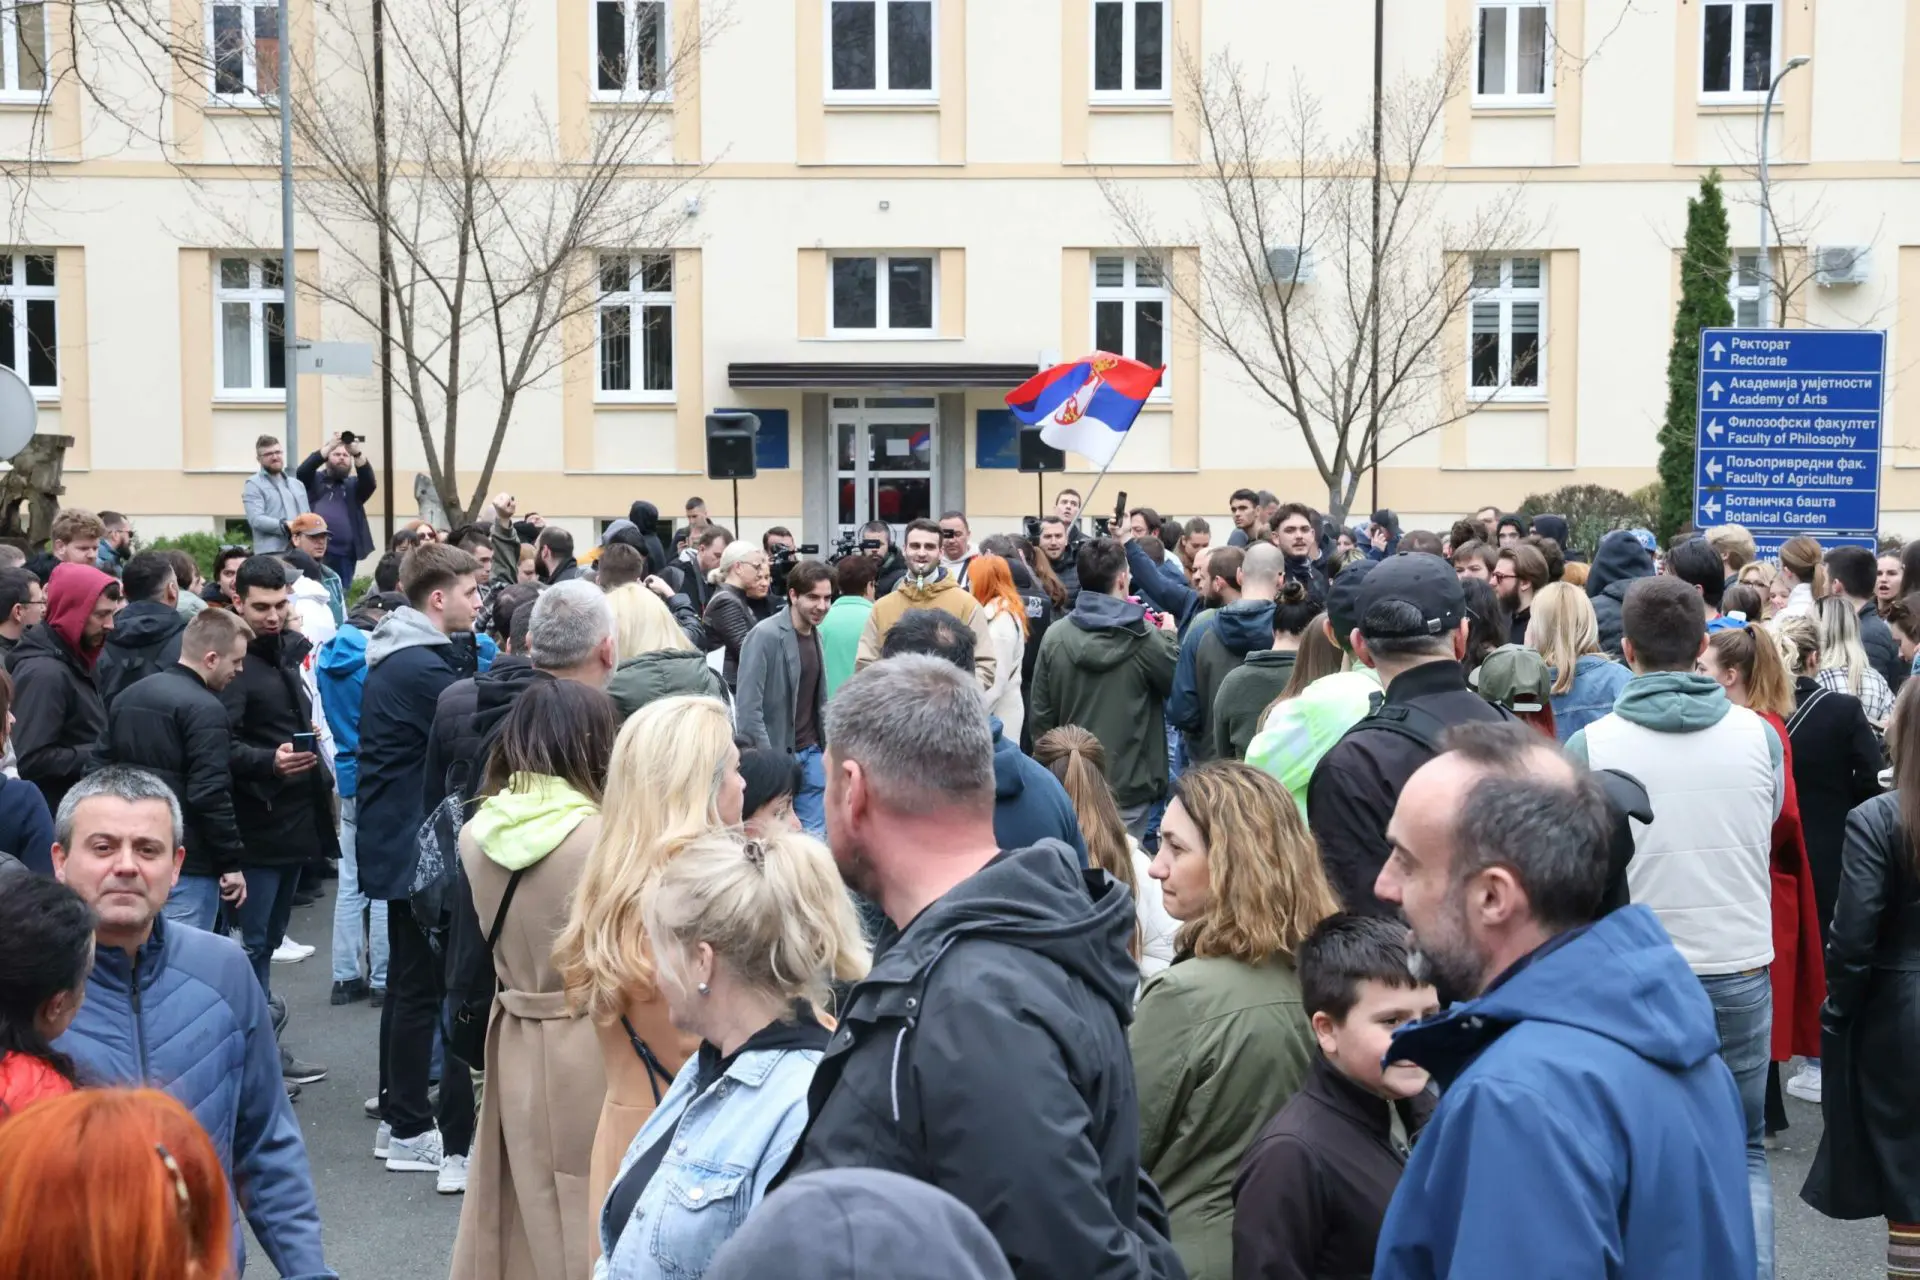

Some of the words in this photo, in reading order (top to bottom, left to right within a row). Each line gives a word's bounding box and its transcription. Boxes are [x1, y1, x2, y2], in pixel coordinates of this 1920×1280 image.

[1731, 337, 1791, 352] Ректорат
[1730, 353, 1788, 367] Rectorate
[1730, 376, 1797, 391] Академија
[1801, 376, 1873, 392] умјетности
[1729, 393, 1783, 407] Academy
[1787, 394, 1800, 405] of
[1803, 394, 1828, 405] Arts
[1728, 416, 1811, 430] Филозофски
[1814, 418, 1876, 432] факултет
[1728, 432, 1771, 446] Faculty
[1774, 433, 1787, 444] of
[1789, 433, 1856, 448] Philosophy
[1726, 455, 1834, 470] Пољопривредни
[1836, 457, 1866, 471] фак.
[1726, 472, 1769, 486] Faculty
[1772, 473, 1785, 484] of
[1787, 473, 1854, 487] Agriculture
[1725, 494, 1793, 507] Ботаничка
[1796, 495, 1836, 508] башта
[1725, 511, 1780, 523] Botanical
[1783, 512, 1827, 524] Garden
